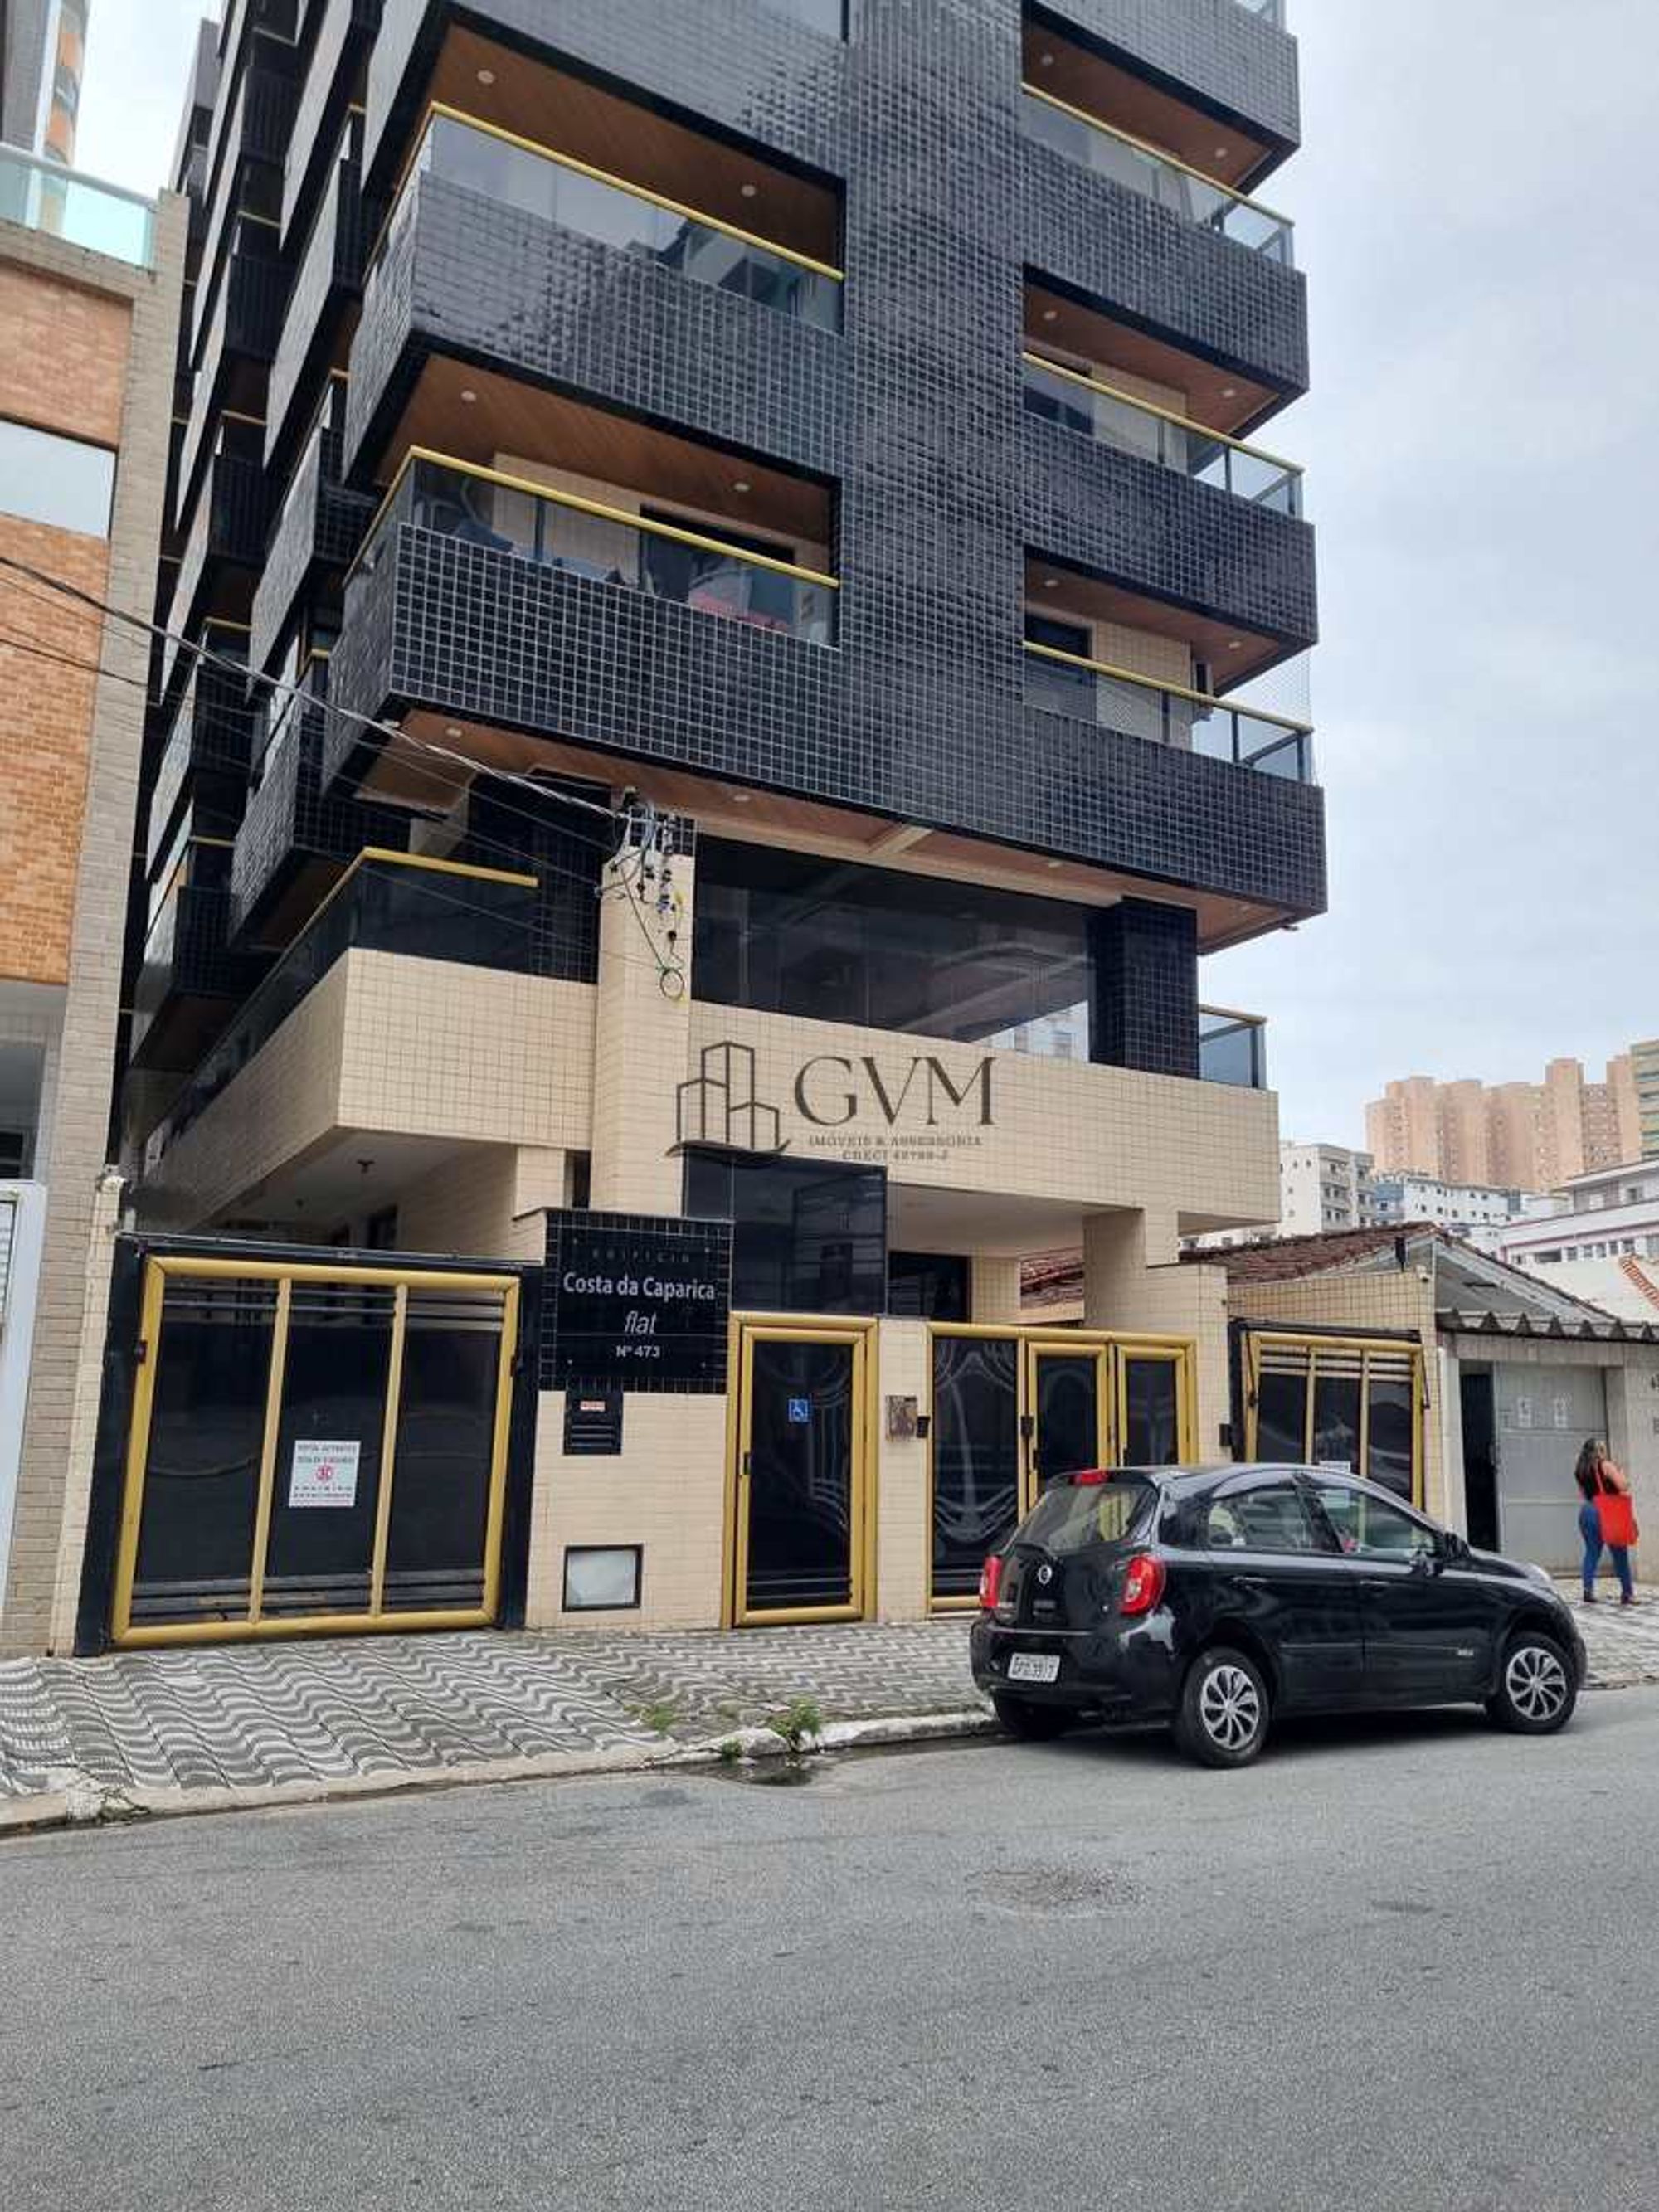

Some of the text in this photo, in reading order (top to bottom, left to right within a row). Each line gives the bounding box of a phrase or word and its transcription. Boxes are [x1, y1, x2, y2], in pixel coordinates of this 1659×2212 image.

[563, 1271, 715, 1303] Costa da Caparica
[624, 1310, 657, 1334] flat
[634, 1345, 661, 1359] 473
